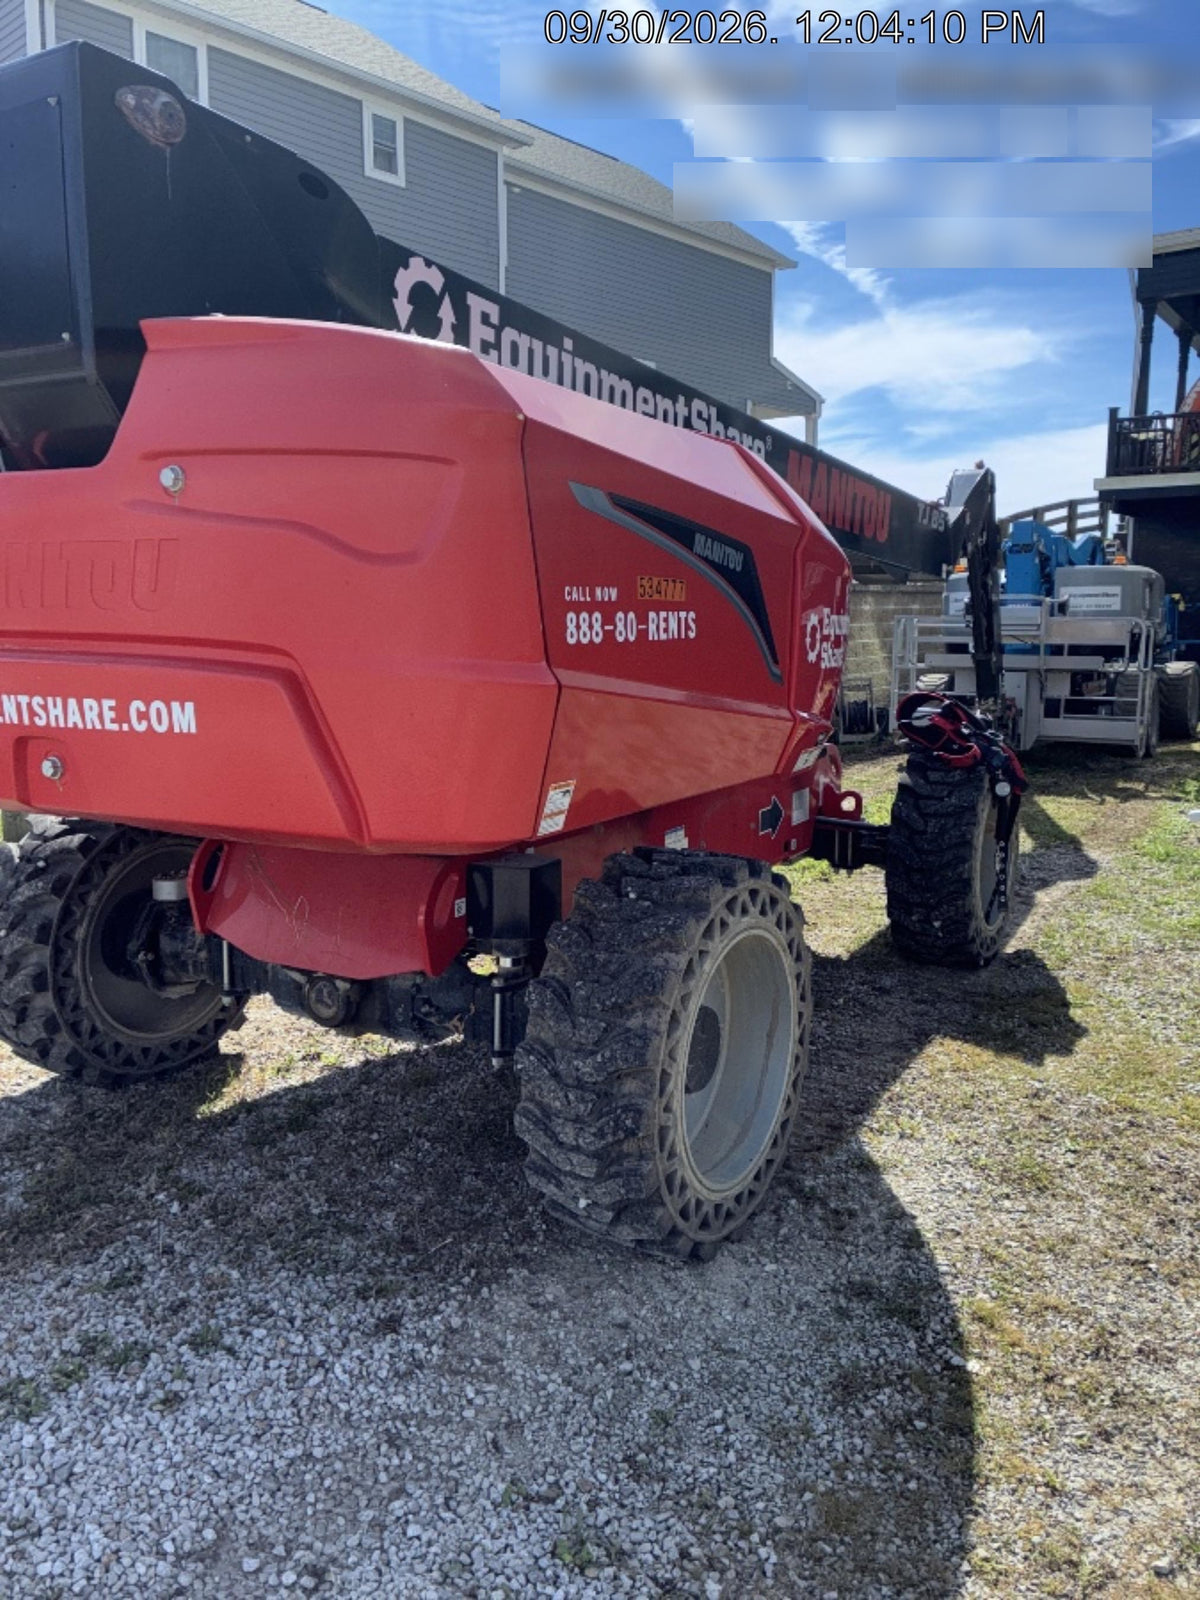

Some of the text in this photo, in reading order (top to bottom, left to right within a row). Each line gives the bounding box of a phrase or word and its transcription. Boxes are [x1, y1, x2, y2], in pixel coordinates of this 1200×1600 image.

[785, 449, 892, 543] MANITOU
[693, 532, 744, 572] MANITOU
[564, 586, 618, 602] CALL NOW
[638, 577, 686, 600] 534777
[566, 611, 697, 645] 888-80-RENTS
[0, 694, 197, 734] NTSHARE.COM
